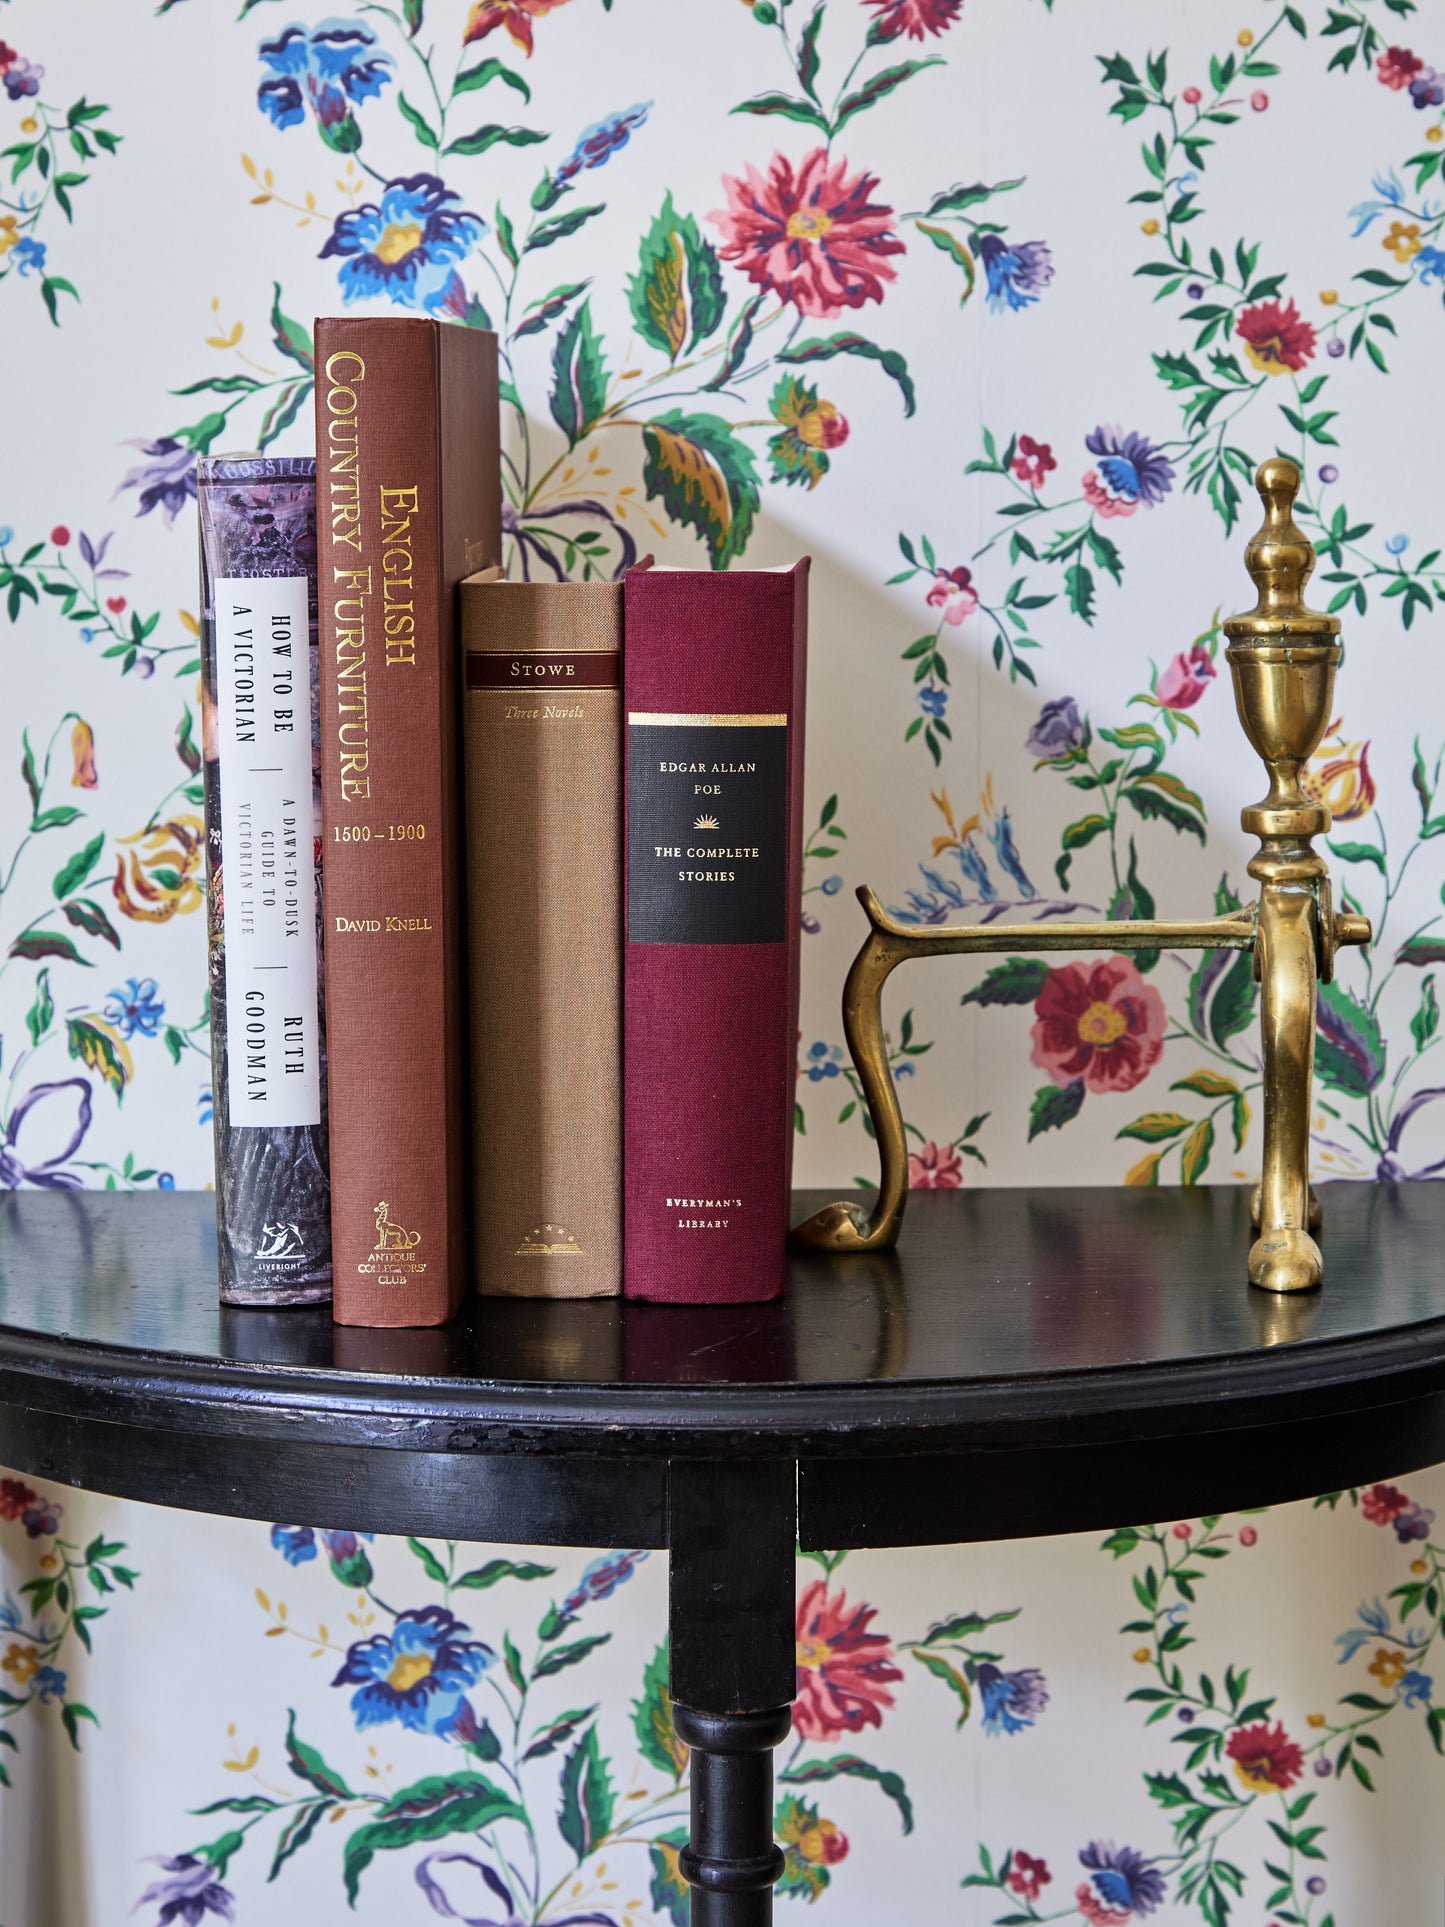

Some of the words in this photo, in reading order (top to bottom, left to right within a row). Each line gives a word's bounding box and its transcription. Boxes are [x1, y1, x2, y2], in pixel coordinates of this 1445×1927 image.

[325, 350, 365, 553] COUNTRY
[380, 484, 419, 667] ENGLISH
[233, 605, 253, 616] A
[271, 615, 292, 658] HOW
[510, 661, 576, 677] STOWE
[234, 629, 256, 742] VICTORIAN
[273, 670, 293, 695] TO
[334, 565, 372, 802] FURNITURE
[274, 709, 294, 732] BE
[505, 705, 540, 720] Three
[543, 705, 585, 719] Novels
[660, 762, 707, 773] EDGAR
[711, 762, 756, 773] ALLAN
[694, 784, 721, 795] POE
[238, 803, 253, 889] VICTORIAN
[261, 831, 275, 878] GUIDE
[655, 847, 681, 858] THE
[686, 847, 760, 858] COMPLETE
[283, 818, 299, 937] DAWN-TO-DUSK
[678, 871, 736, 882] STORIES
[263, 889, 276, 907] TO
[241, 901, 255, 935] LIFE
[335, 917, 381, 932] DAVID
[384, 917, 432, 932] KNELL
[245, 991, 267, 1101] GOODMAN
[284, 1016, 304, 1074] RUTH
[666, 1198, 742, 1207] EVERYMAN'S
[678, 1220, 729, 1228] LIBRARY
[258, 1263, 301, 1271] LIVERIGHT
[368, 1253, 416, 1263] ANTIQUE
[378, 1276, 407, 1285] CLUB
